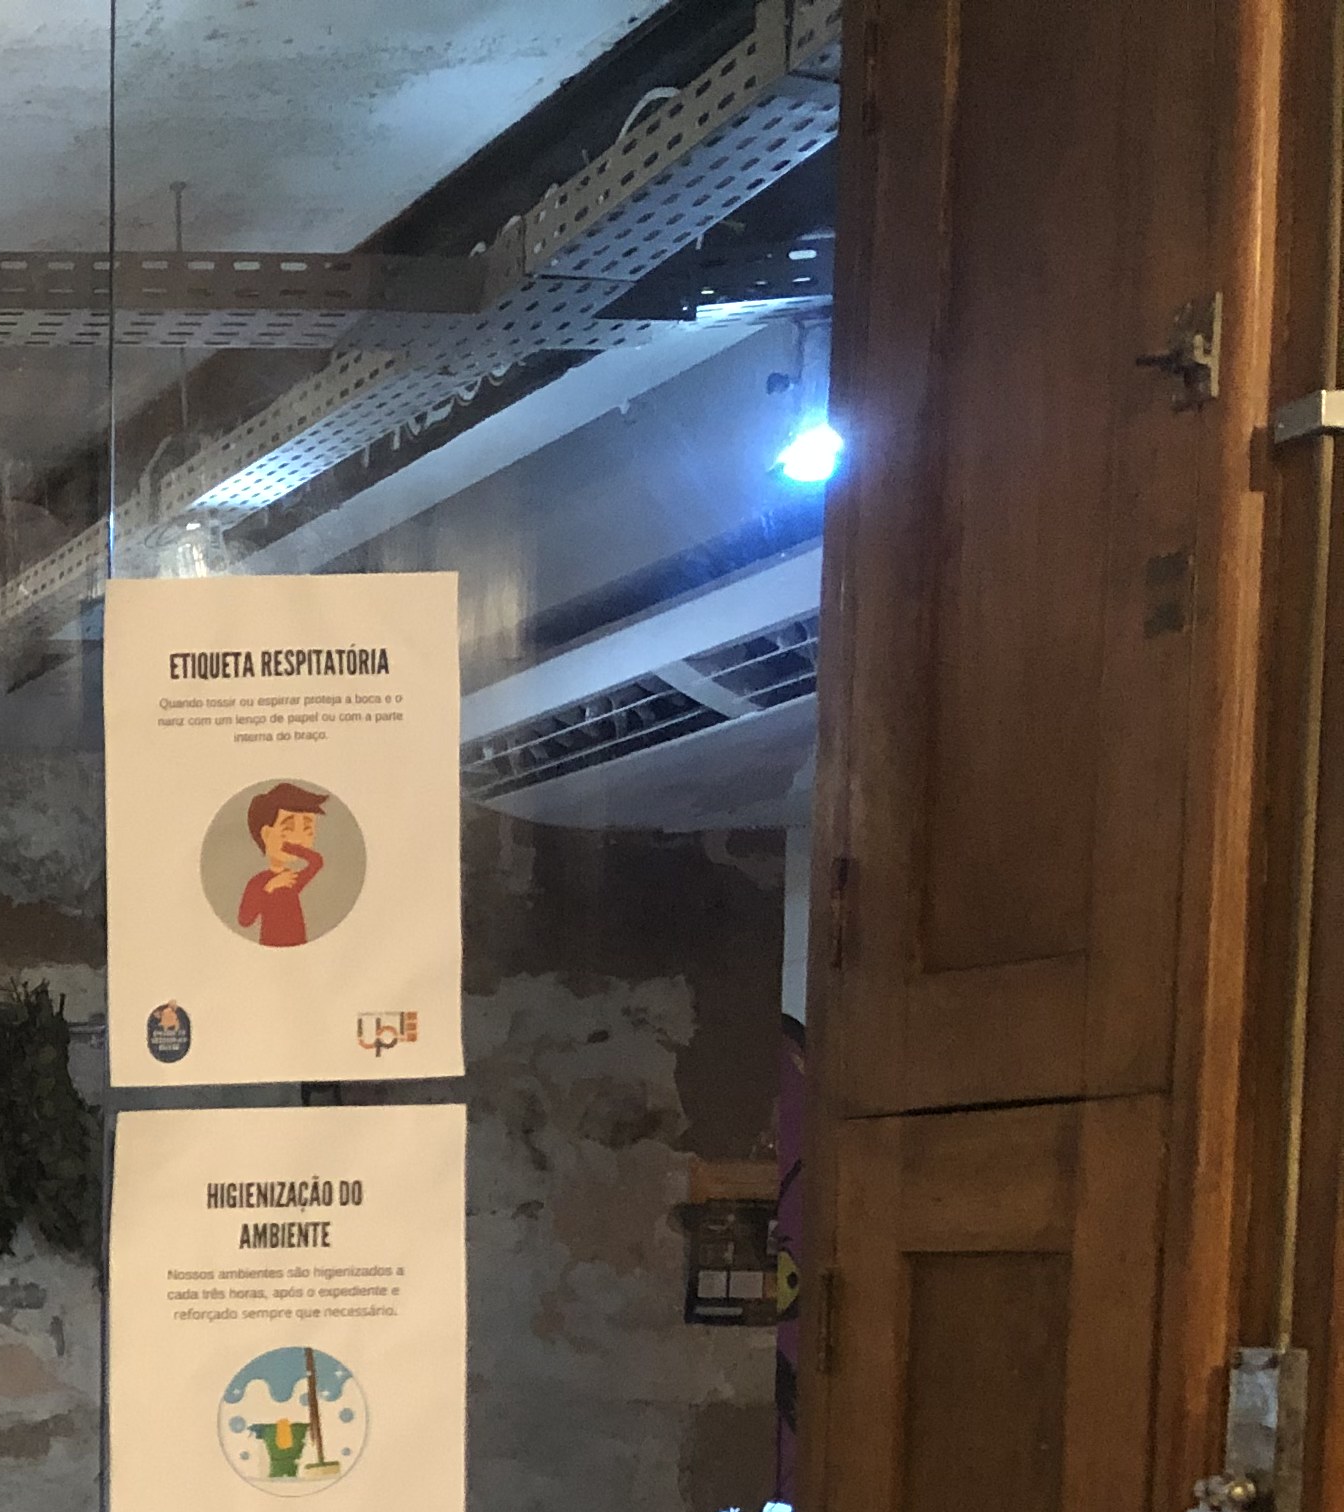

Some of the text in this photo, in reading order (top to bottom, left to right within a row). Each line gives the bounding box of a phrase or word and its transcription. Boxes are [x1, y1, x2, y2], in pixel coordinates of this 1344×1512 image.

[169, 643, 390, 680] ETIQUETA RESPITATÓRIA
[159, 693, 403, 710] Quando tossir ou espirrar proteja a boca e o
[158, 711, 403, 727] nariz com um lenço de papel ou com a parte
[233, 730, 328, 743] interna do braço.
[207, 1175, 363, 1213] HIGIENIZAÇÃO DO
[239, 1221, 331, 1249] AMBIENTE
[167, 1264, 404, 1280] Nossos ambientes são higienizados a
[167, 1284, 400, 1301] cada três horas, após o expediente e
[173, 1304, 398, 1323] reforçado sempre que necessário.
